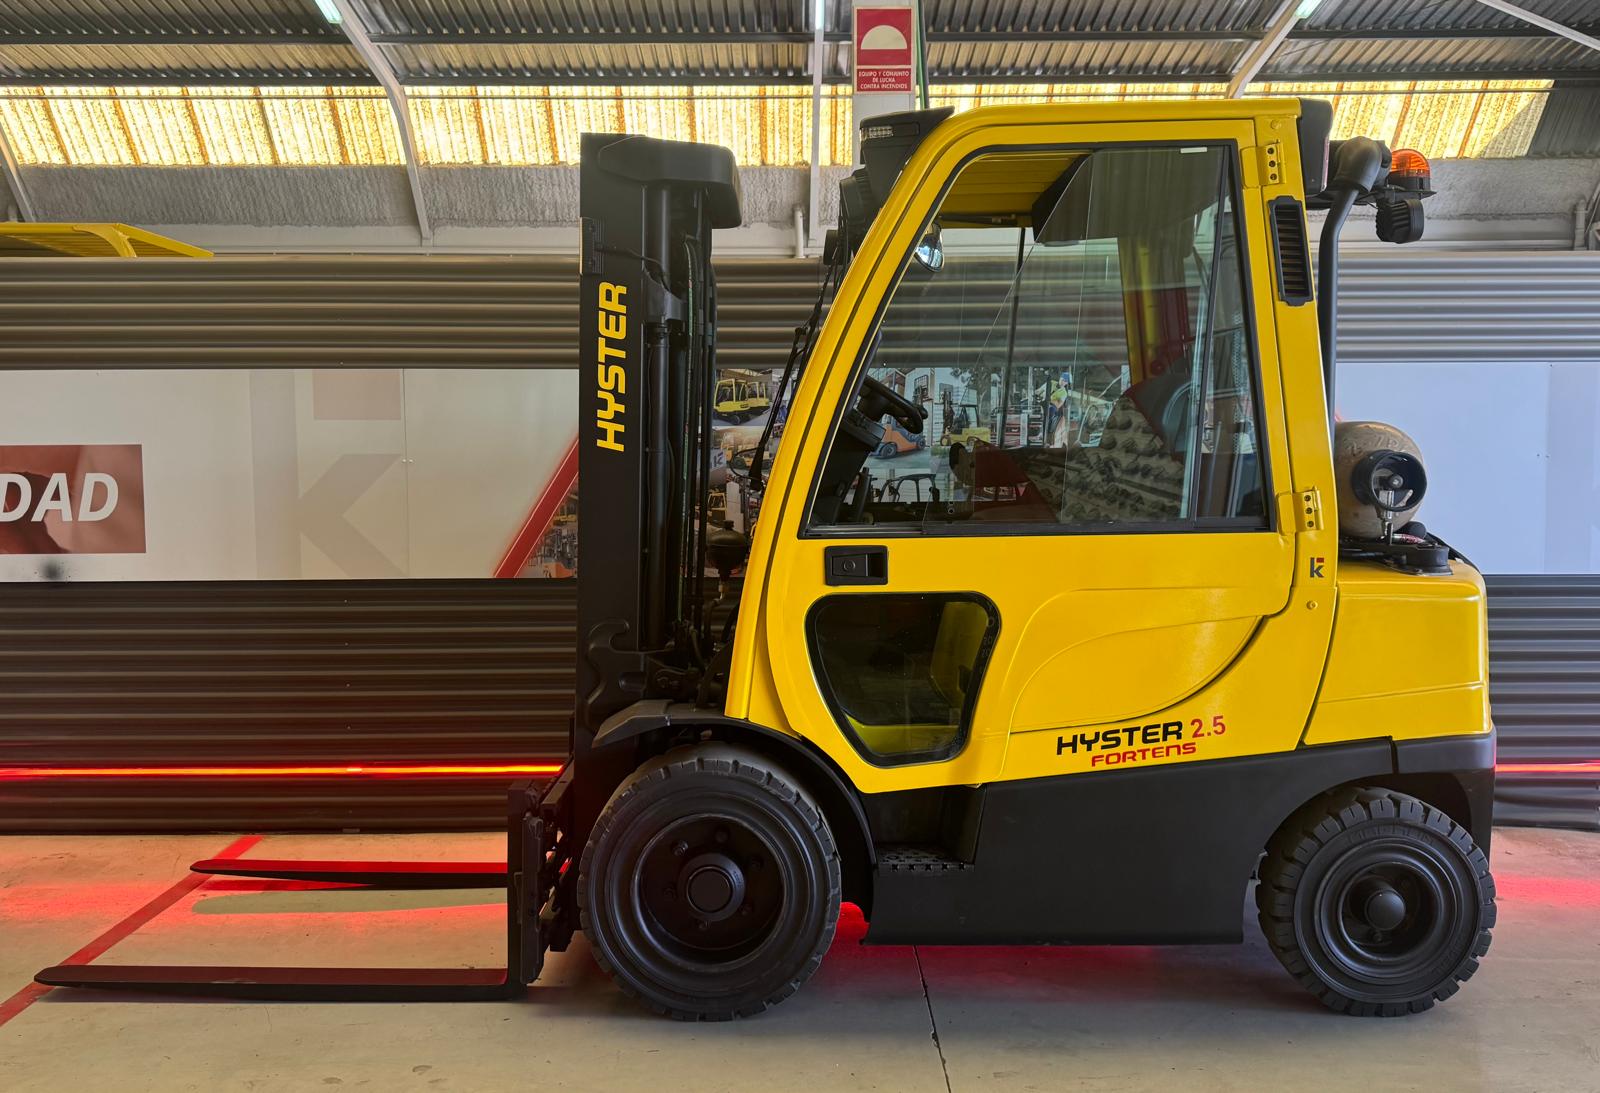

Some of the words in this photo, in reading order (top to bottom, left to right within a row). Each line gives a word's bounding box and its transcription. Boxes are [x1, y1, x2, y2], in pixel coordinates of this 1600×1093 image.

[597, 281, 627, 452] HYSTER
[1056, 720, 1183, 755] HYSTER
[1190, 715, 1226, 738] 2.5
[1091, 742, 1197, 767] FORTENS
